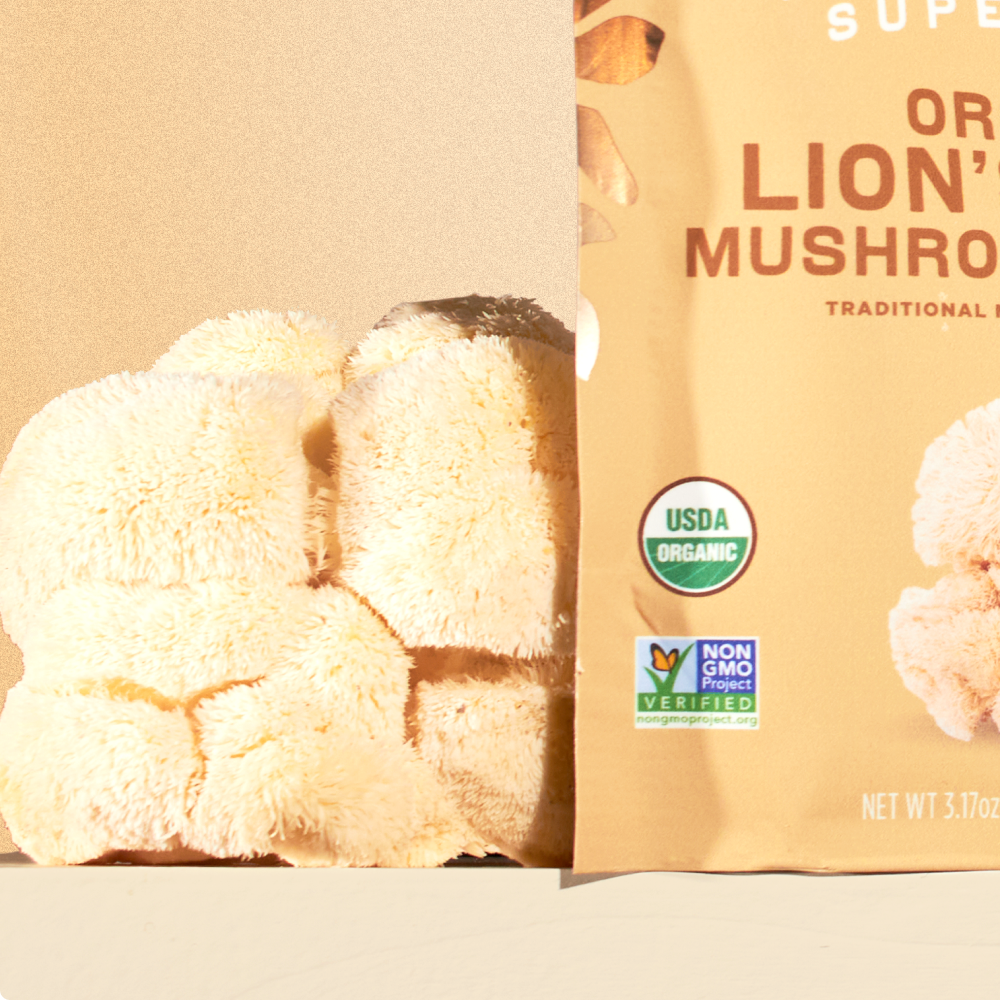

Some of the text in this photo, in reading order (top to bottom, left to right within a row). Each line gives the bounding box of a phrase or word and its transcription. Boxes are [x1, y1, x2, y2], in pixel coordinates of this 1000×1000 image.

[825, 300, 987, 318] TRADITIONAL
[666, 508, 729, 532] USDA
[657, 542, 738, 563] ORGANIC
[702, 643, 752, 660] NON
[702, 660, 753, 677] GMO
[702, 676, 752, 693] Project
[644, 695, 752, 711] VERIFIED
[636, 712, 758, 727] nongmoproject.org
[862, 793, 899, 820] NET
[906, 792, 937, 819] WT
[943, 791, 1000, 819] 3.17oz
